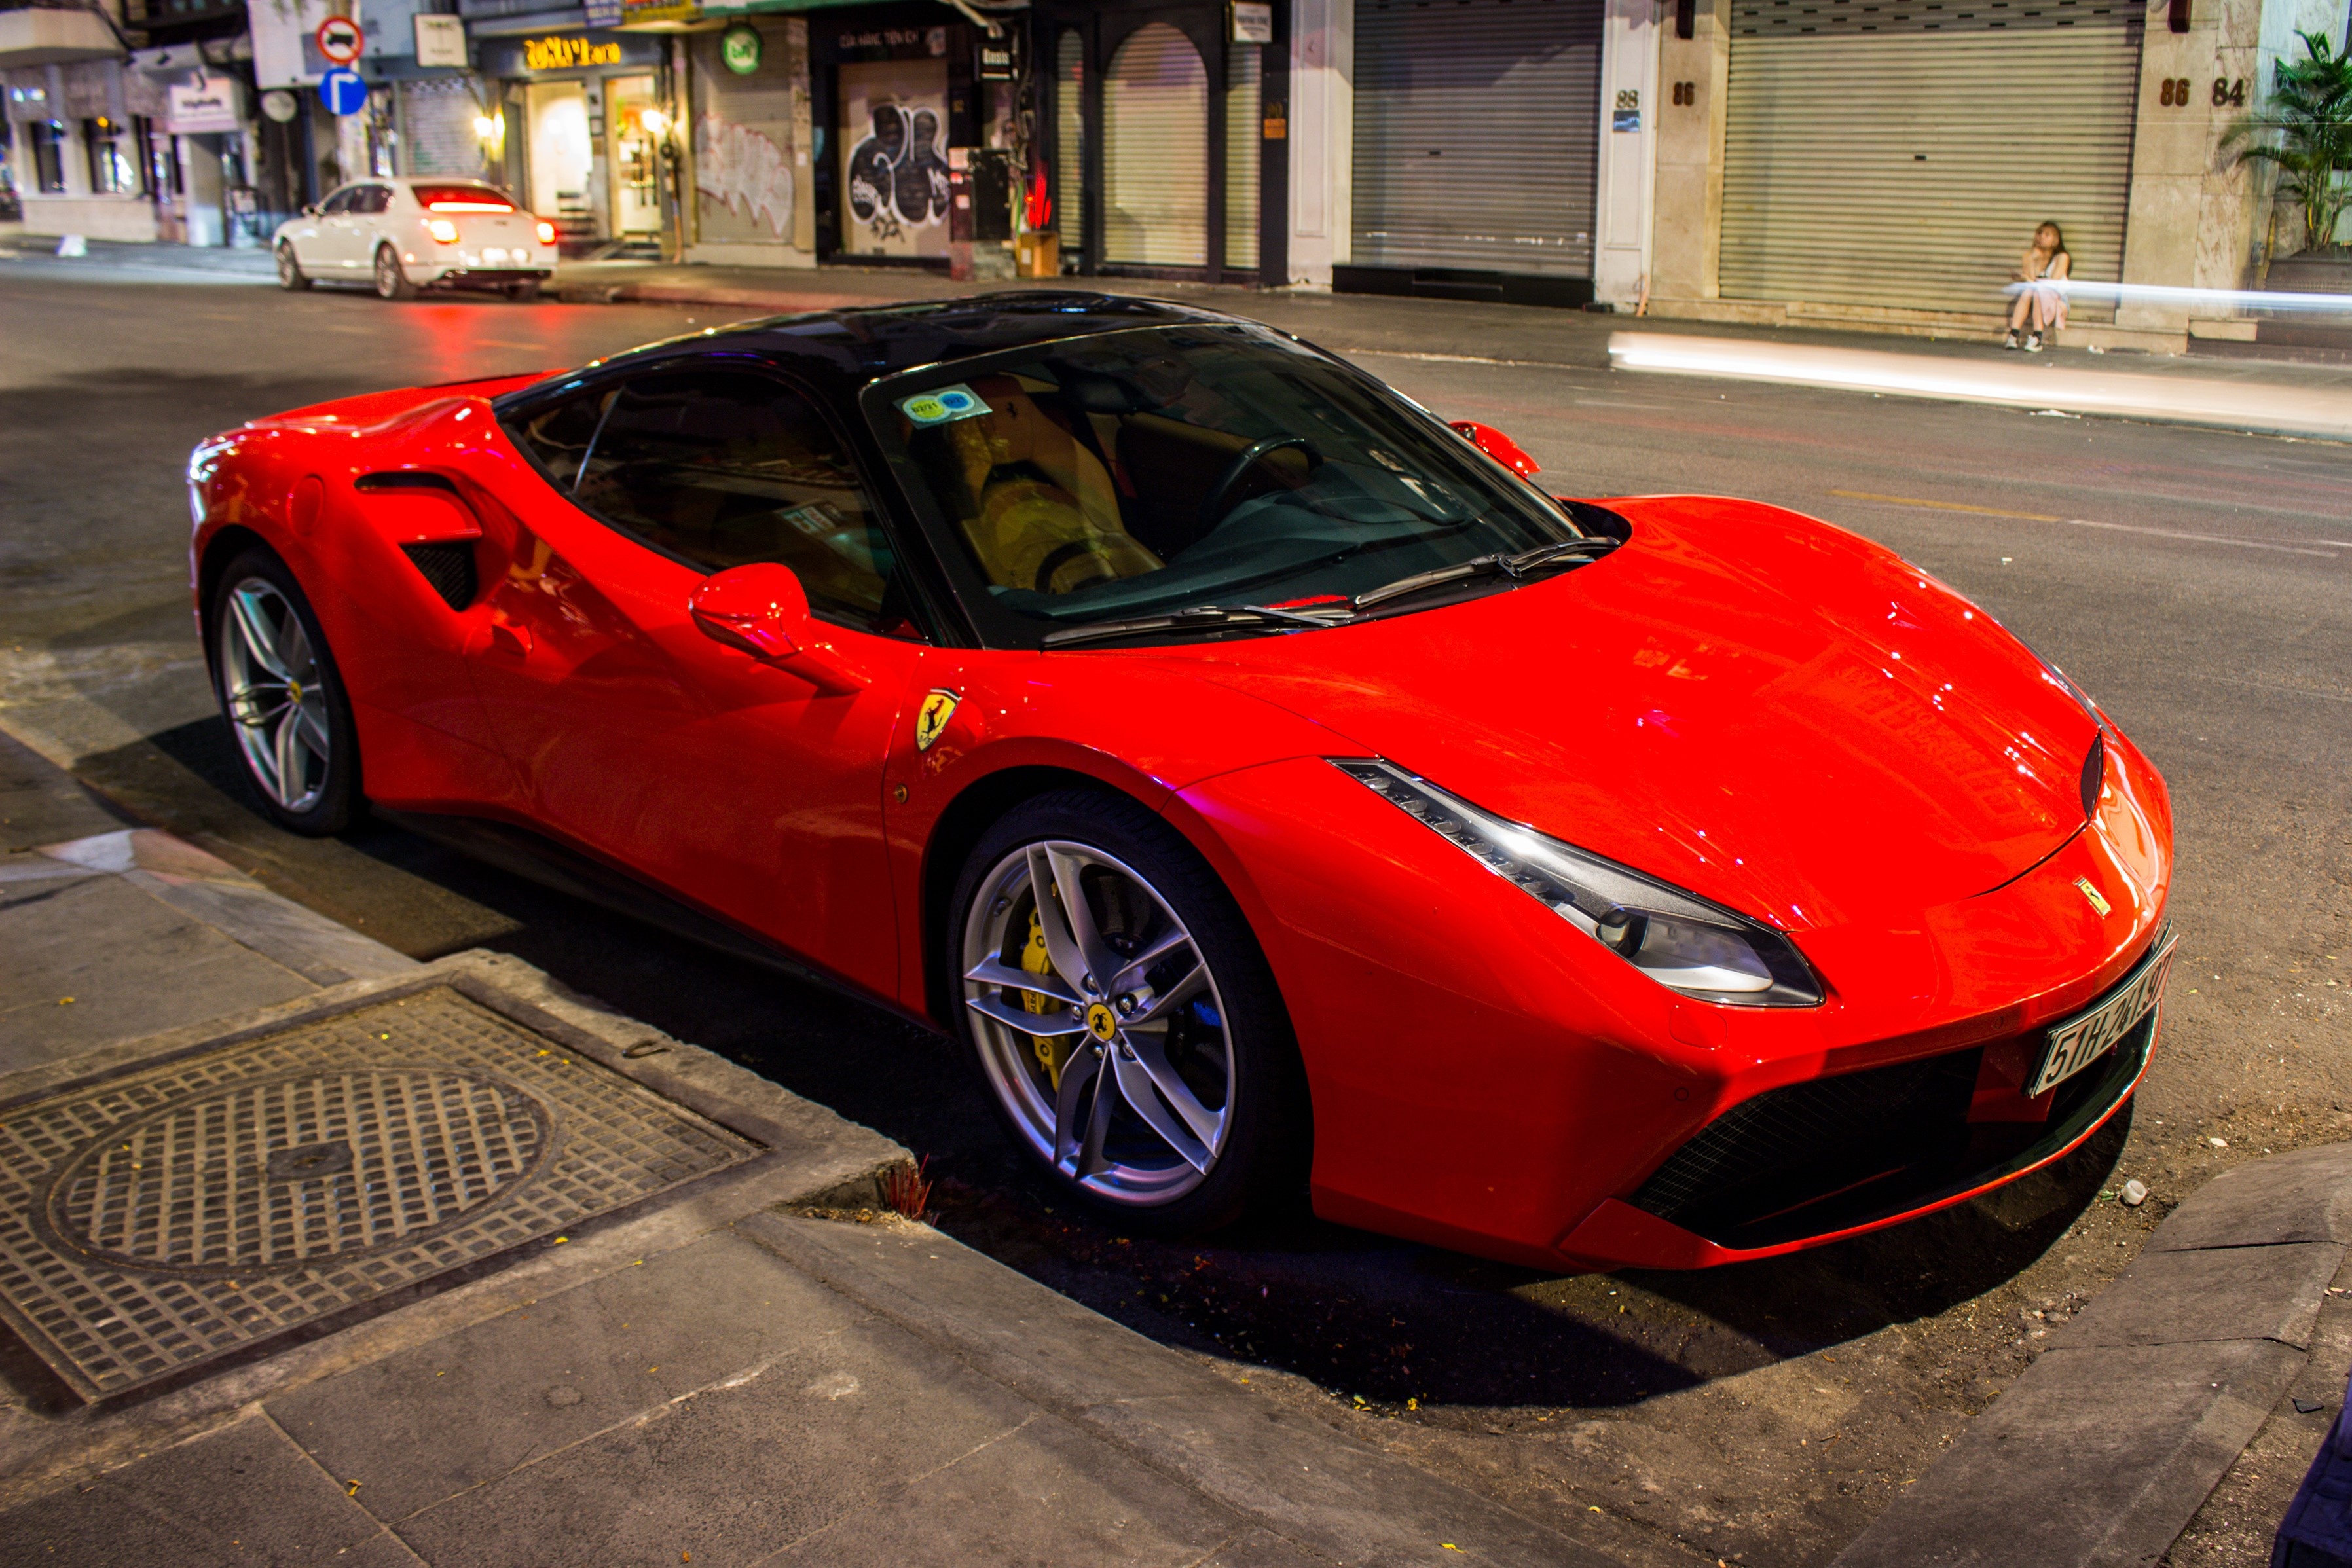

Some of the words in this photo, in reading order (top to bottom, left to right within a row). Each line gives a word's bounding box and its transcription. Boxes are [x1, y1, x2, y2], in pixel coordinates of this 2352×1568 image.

[1616, 90, 1638, 108] 88
[1673, 81, 1695, 106] 86
[2160, 77, 2190, 107] 86
[2212, 77, 2245, 107] 84
